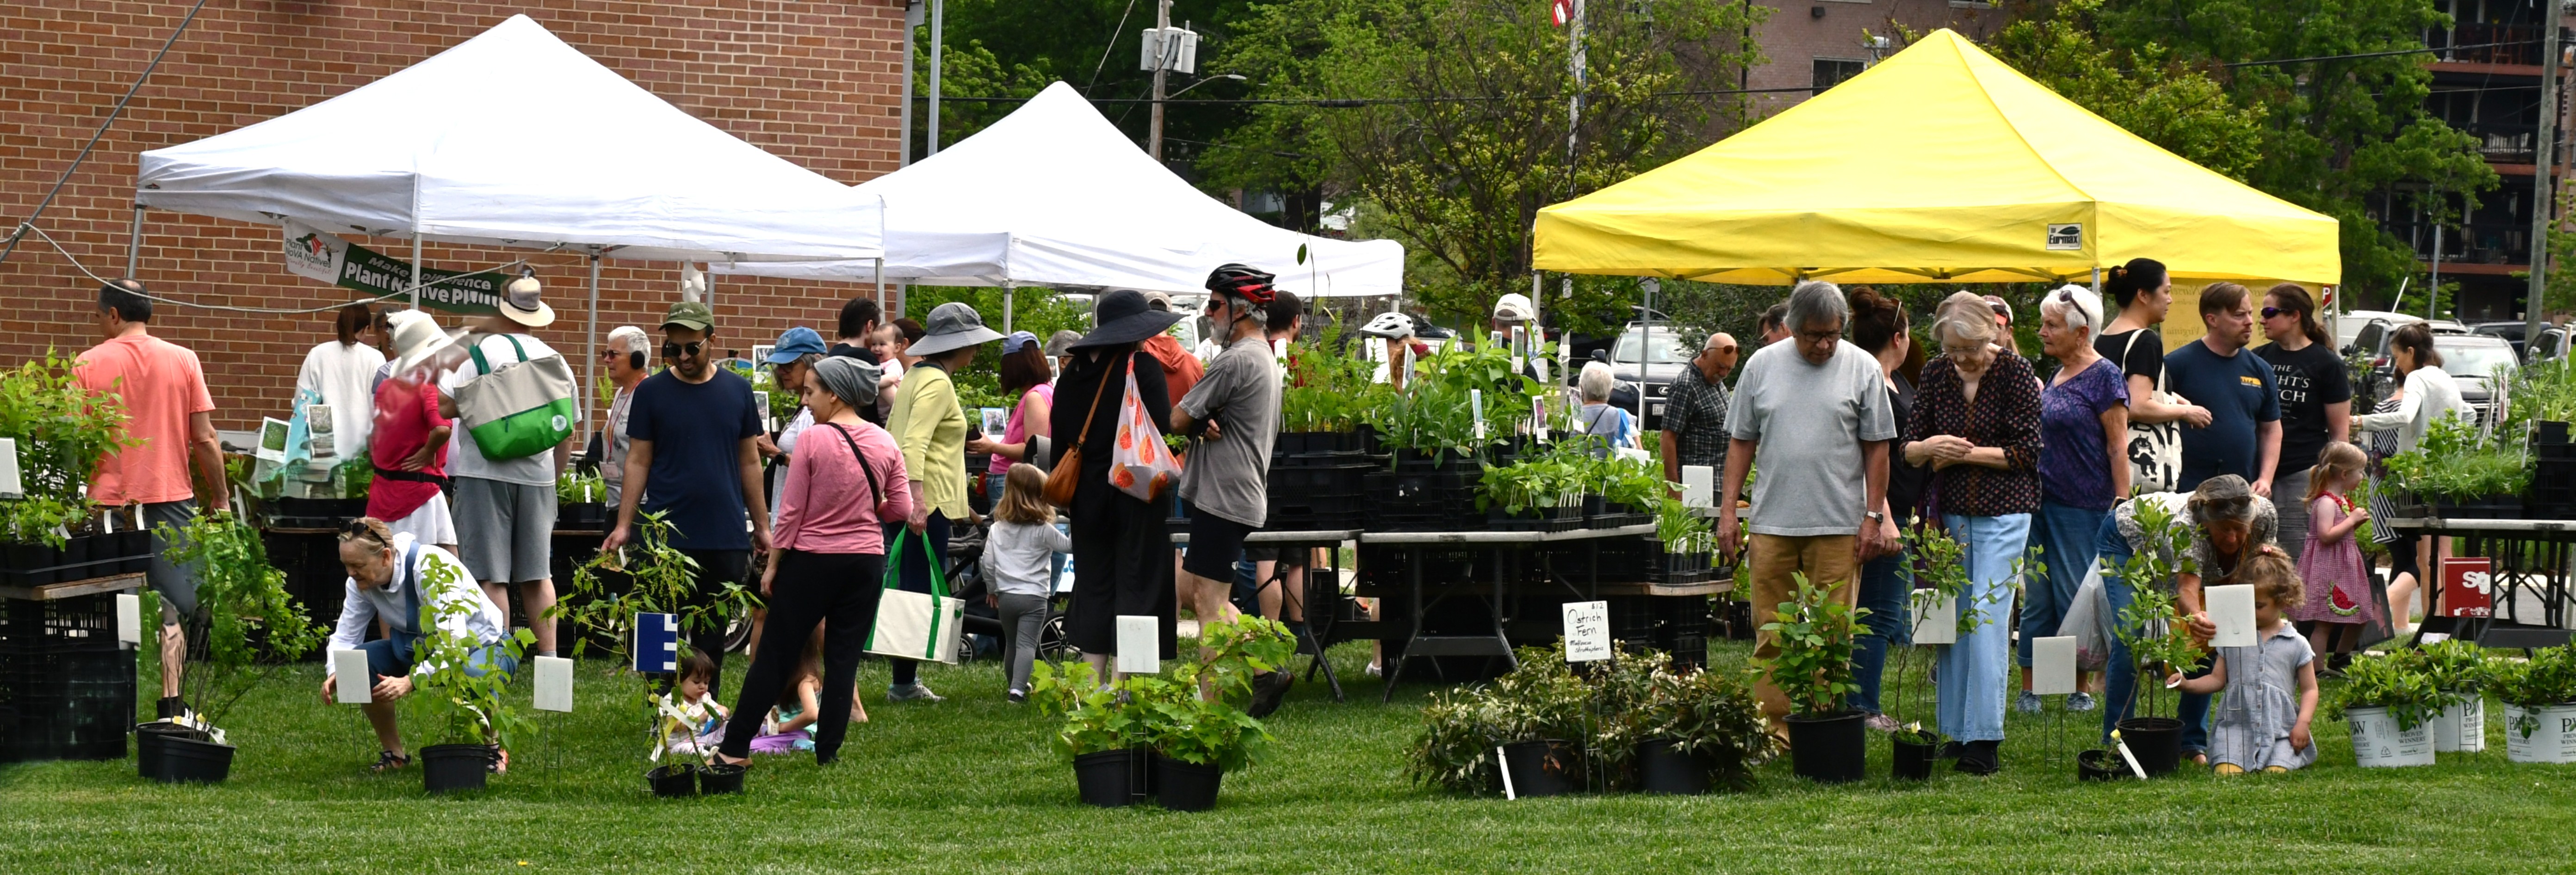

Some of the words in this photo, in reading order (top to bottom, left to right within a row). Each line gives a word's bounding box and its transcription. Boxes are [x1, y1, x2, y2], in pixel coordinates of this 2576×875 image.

[286, 238, 303, 250] Plant
[2049, 234, 2078, 244] Eurmax
[285, 247, 302, 259] NoVA
[304, 253, 332, 268] Natives
[368, 257, 409, 277] Make
[345, 261, 390, 290] Plant
[391, 279, 449, 303] Naive
[1567, 609, 1602, 624] Ostrich
[1576, 624, 1597, 636] Fern
